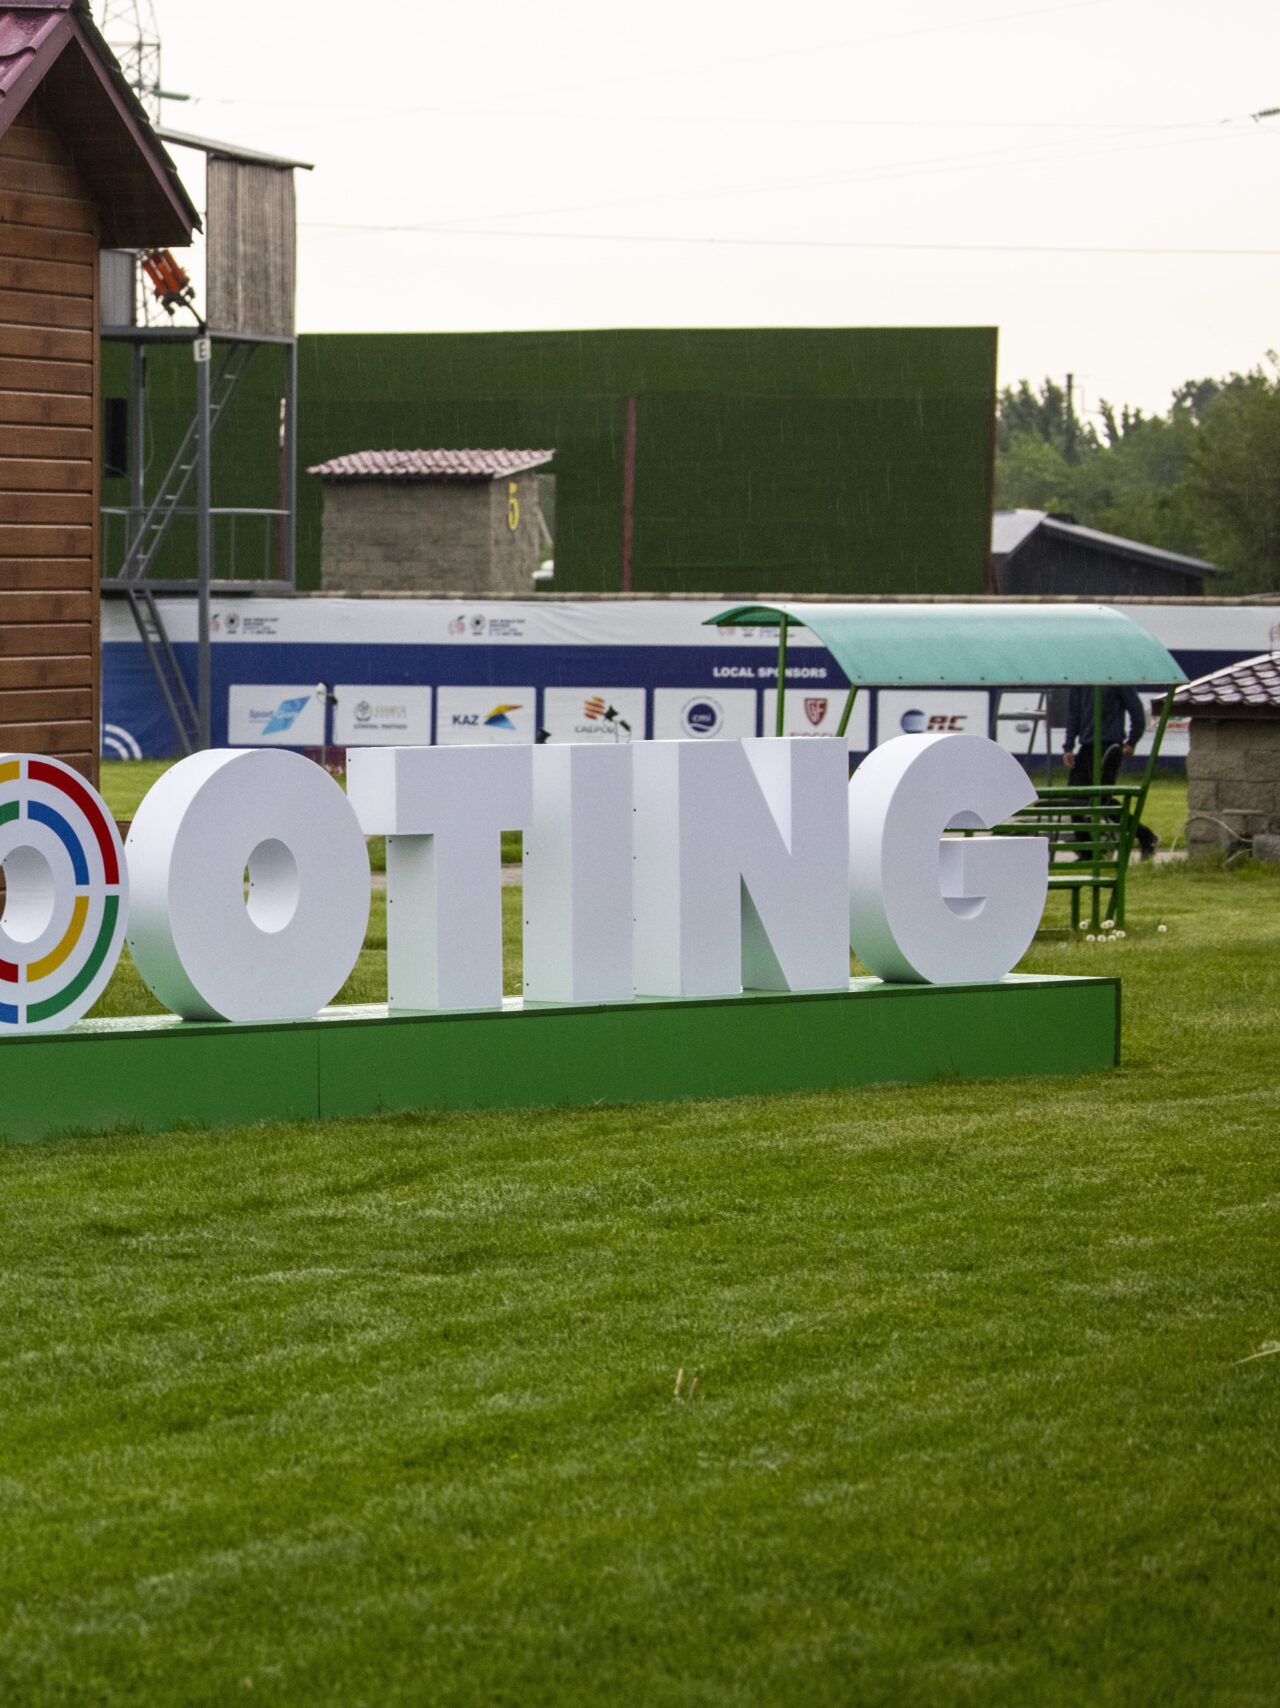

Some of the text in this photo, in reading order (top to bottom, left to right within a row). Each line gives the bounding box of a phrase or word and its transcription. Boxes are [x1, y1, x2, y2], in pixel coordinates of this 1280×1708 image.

[507, 481, 519, 531] 5
[713, 667, 754, 678] LOCAL
[452, 714, 479, 725] KAZ
